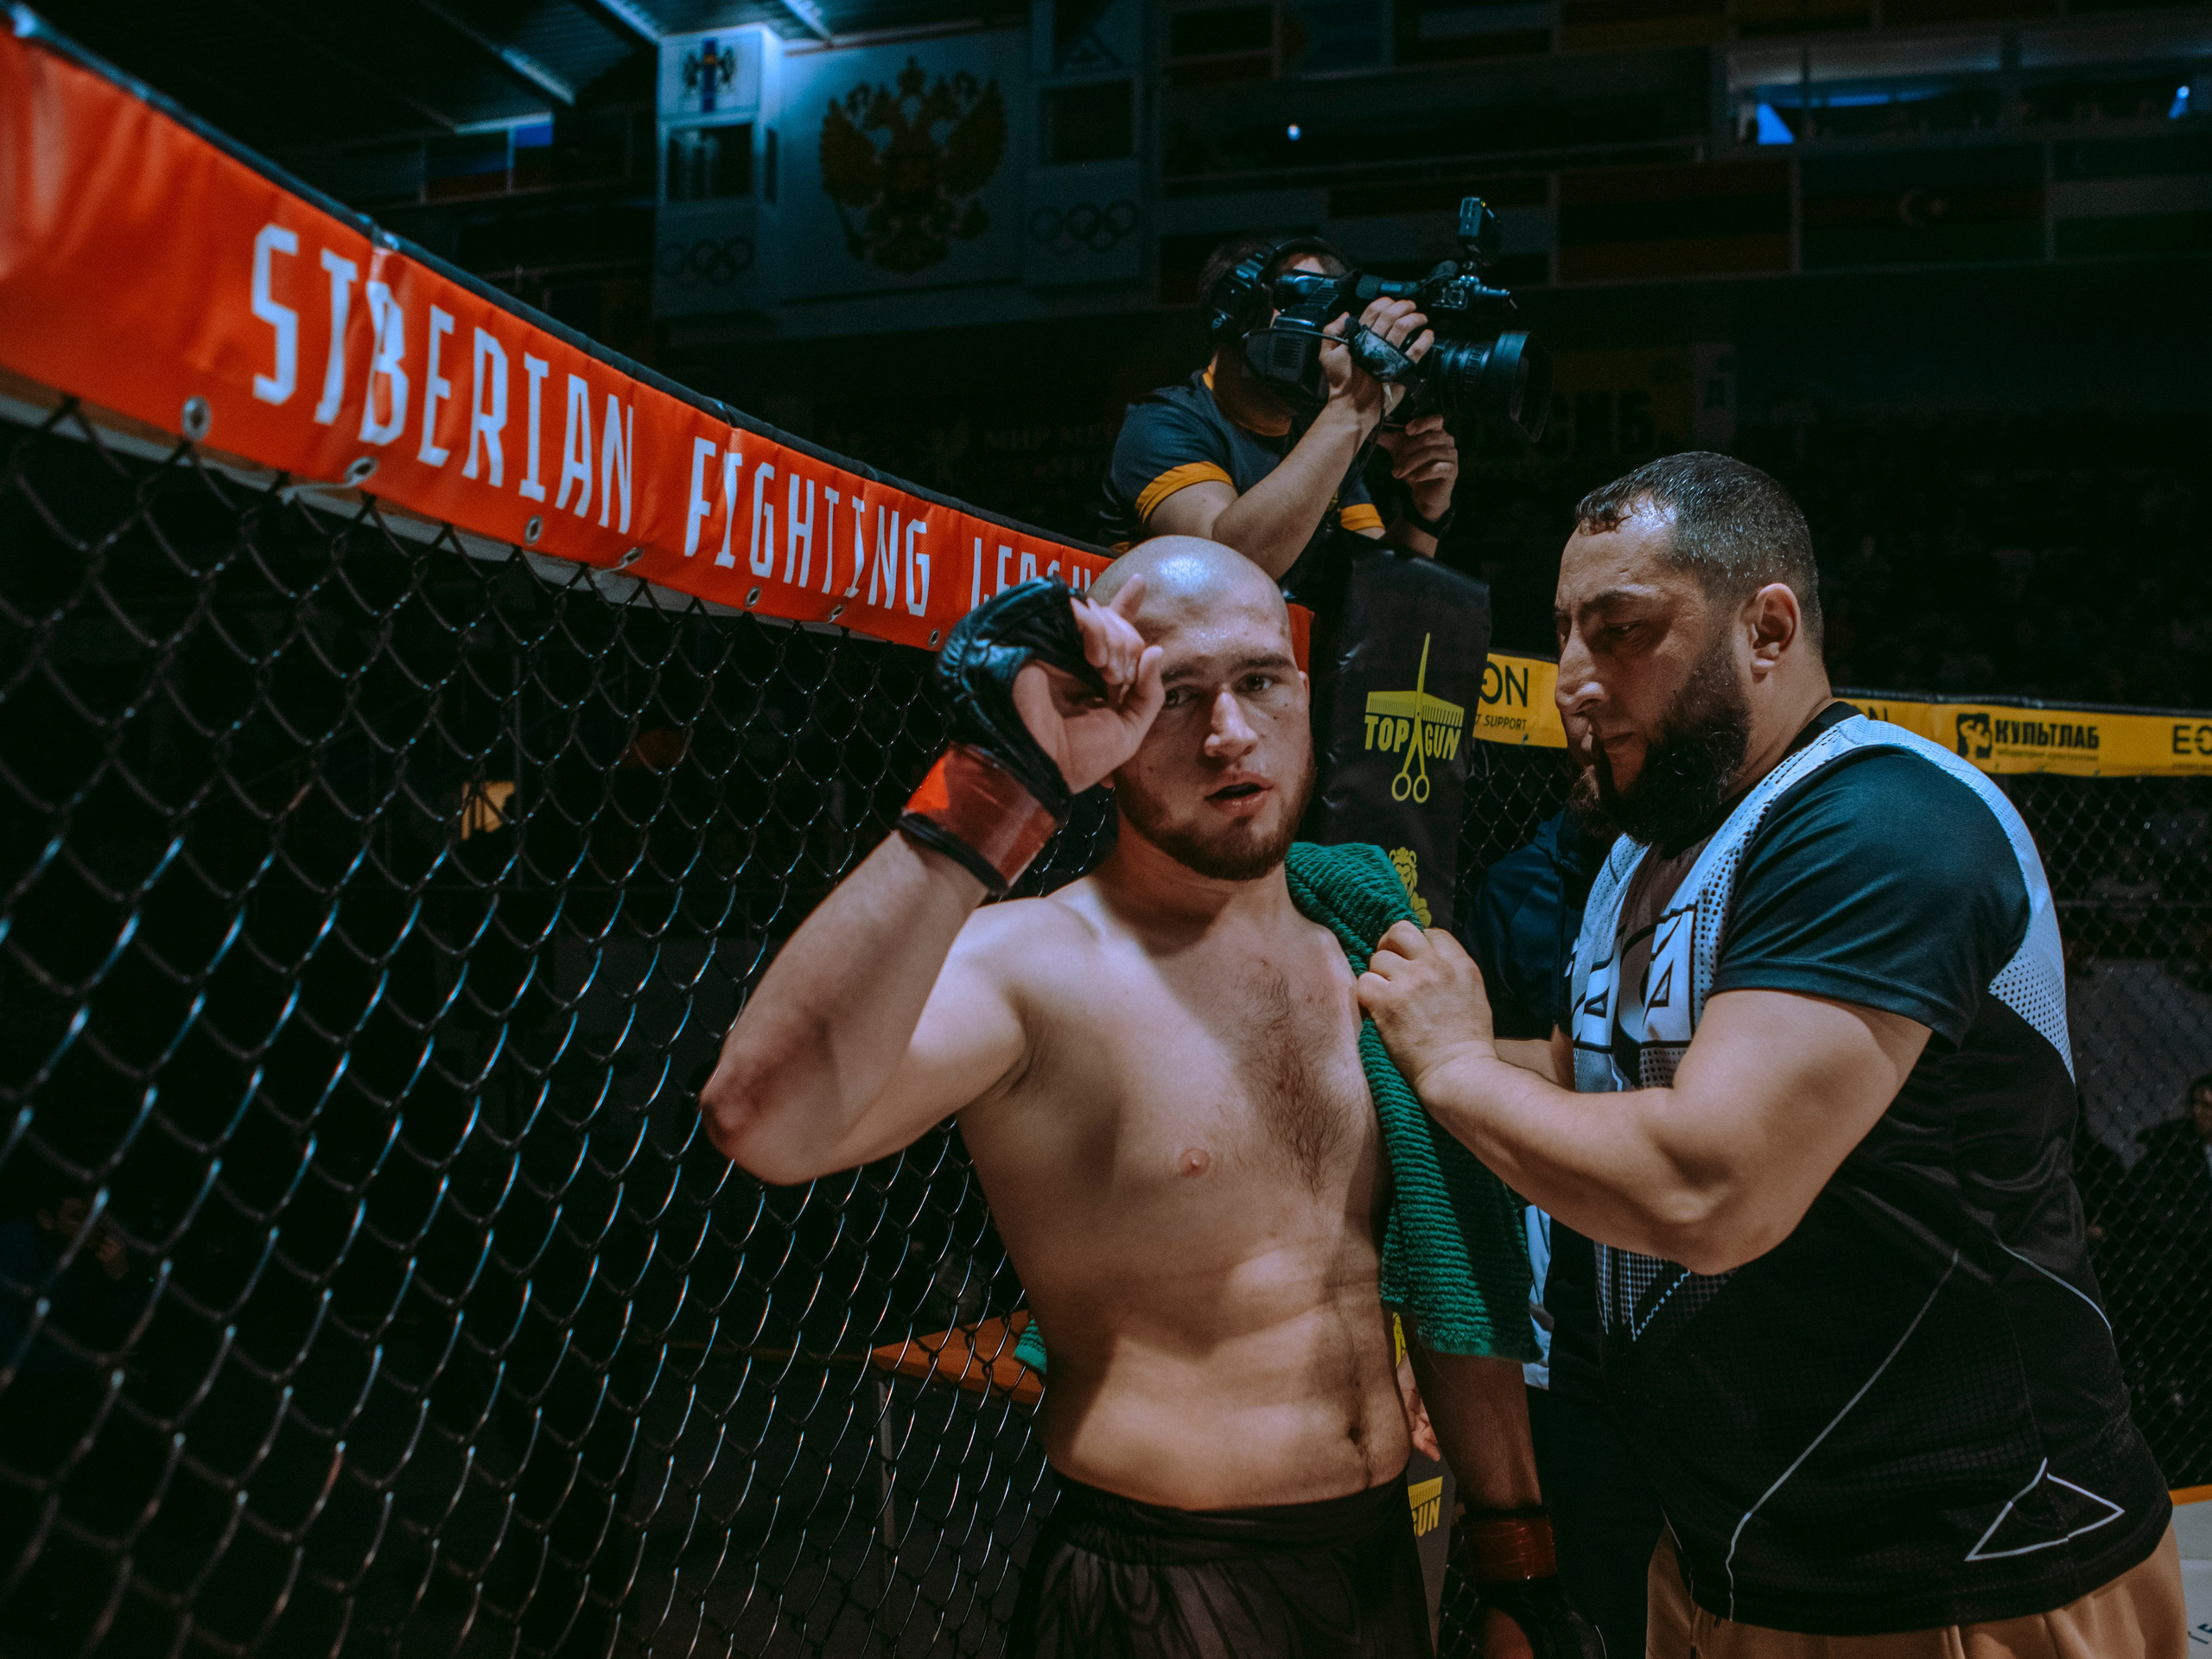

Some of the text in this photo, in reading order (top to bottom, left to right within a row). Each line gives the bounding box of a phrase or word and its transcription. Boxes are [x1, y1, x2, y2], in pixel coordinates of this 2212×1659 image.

[252, 223, 633, 534] SIBERIAN
[684, 436, 930, 617] FIGHTING
[1364, 715, 1461, 760] TOP GUN
[1484, 715, 1527, 730] SUPPORT
[2172, 725, 2212, 755] EO
